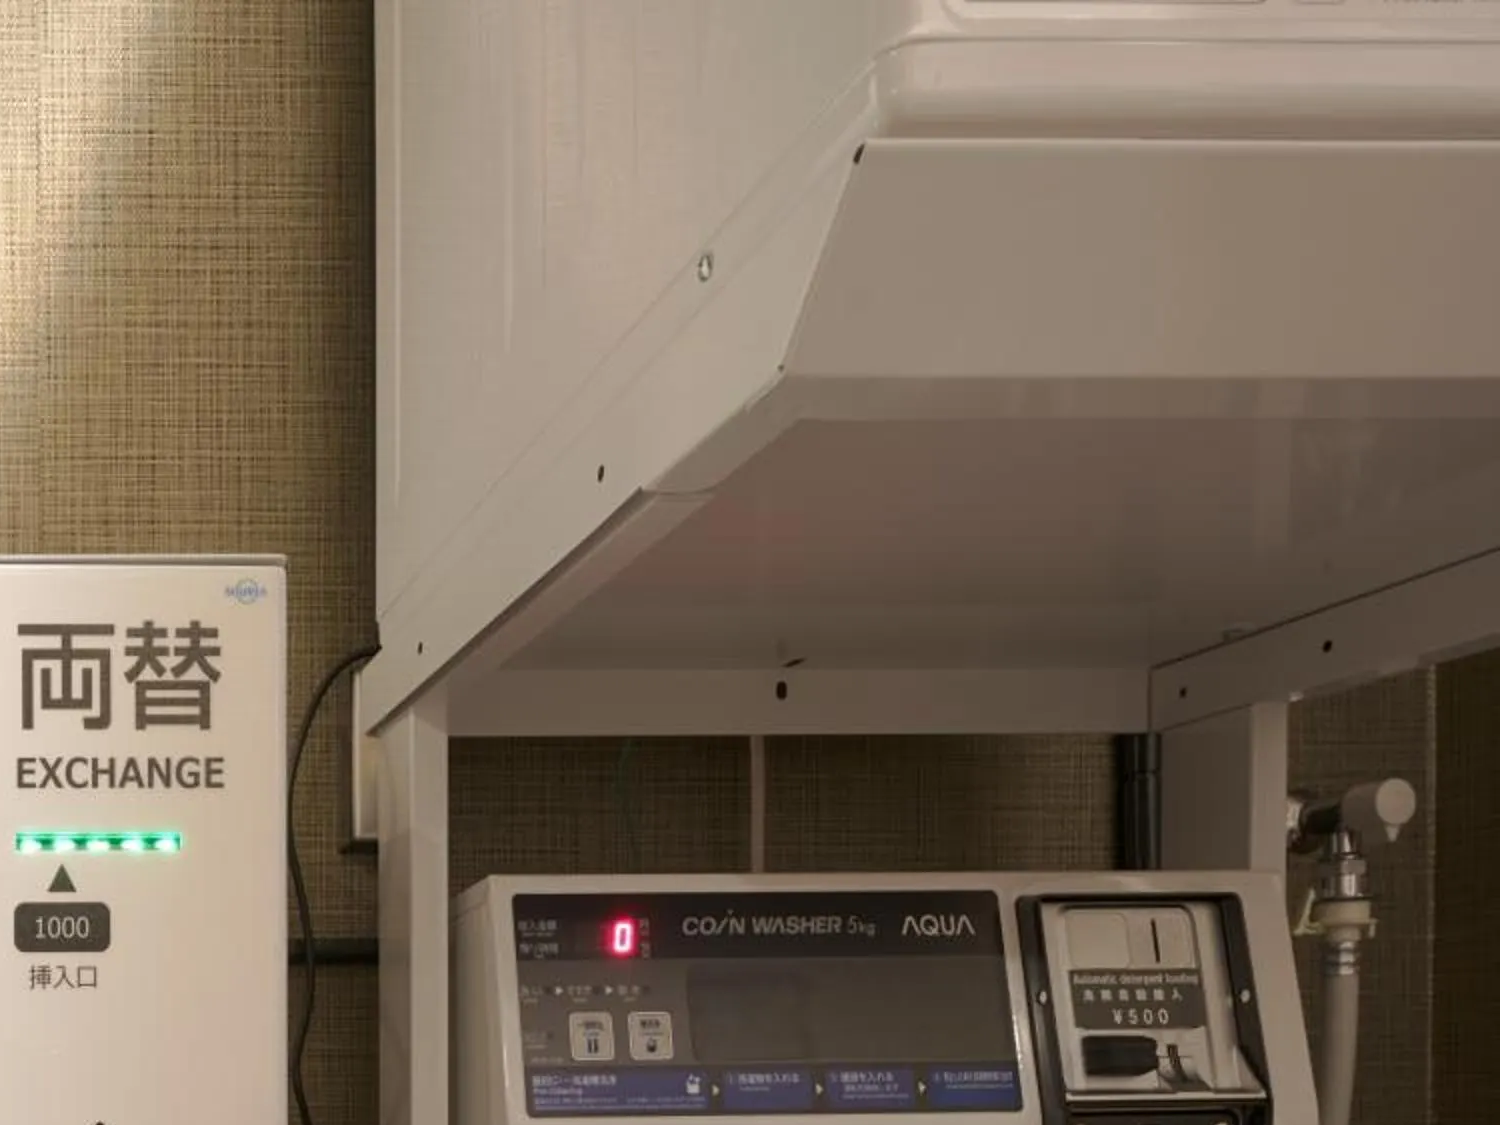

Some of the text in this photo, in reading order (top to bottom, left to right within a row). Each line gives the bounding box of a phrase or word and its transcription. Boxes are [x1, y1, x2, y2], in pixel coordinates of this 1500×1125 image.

[17, 620, 221, 731] 両替
[16, 756, 225, 789] EXCHANGE
[34, 916, 90, 939] 1000
[613, 921, 634, 953] 0
[752, 915, 842, 936] WASHER
[902, 914, 976, 936] AQUA
[30, 965, 97, 990] 挿入口
